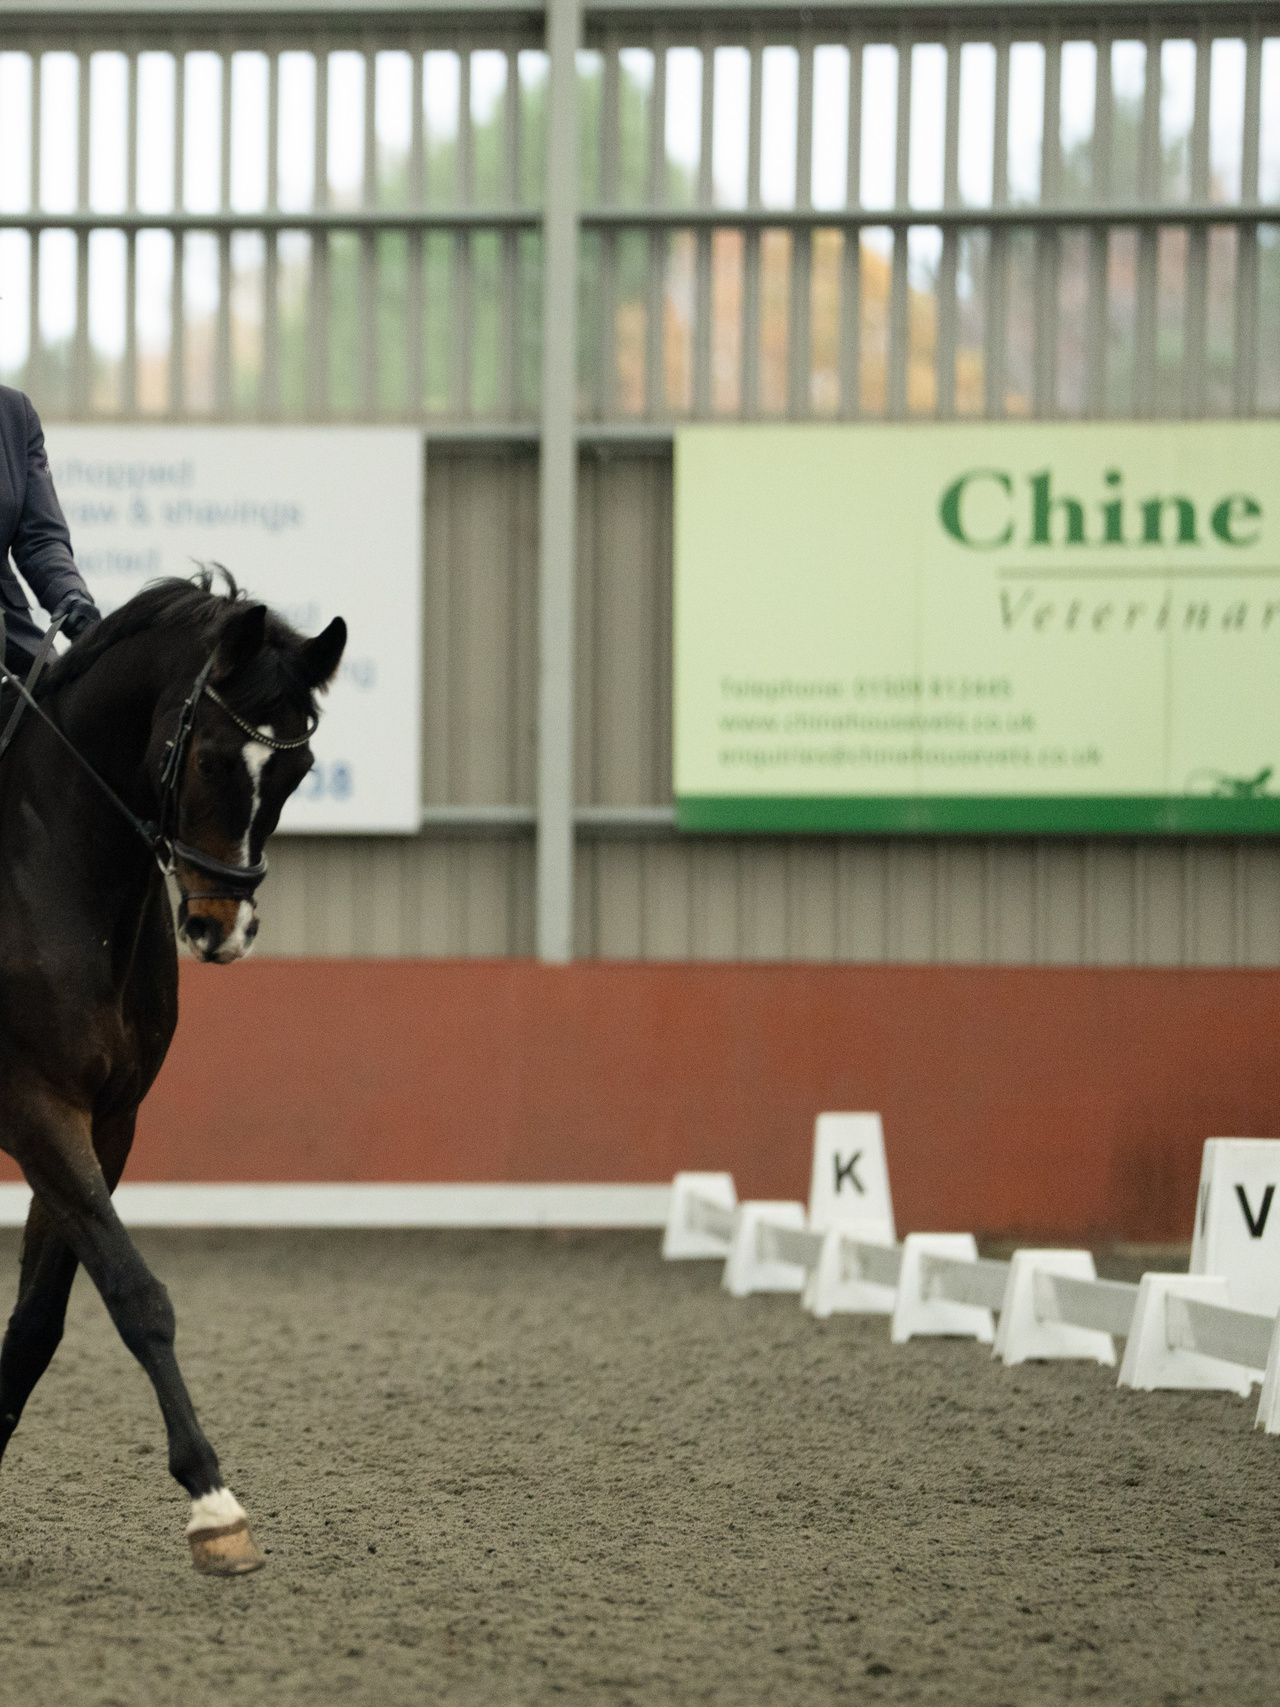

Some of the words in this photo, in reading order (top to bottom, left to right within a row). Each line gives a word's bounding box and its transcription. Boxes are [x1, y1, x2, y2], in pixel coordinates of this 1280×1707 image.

[937, 465, 1264, 552] Chine
[832, 1151, 866, 1196] K
[1234, 1184, 1276, 1238] V
